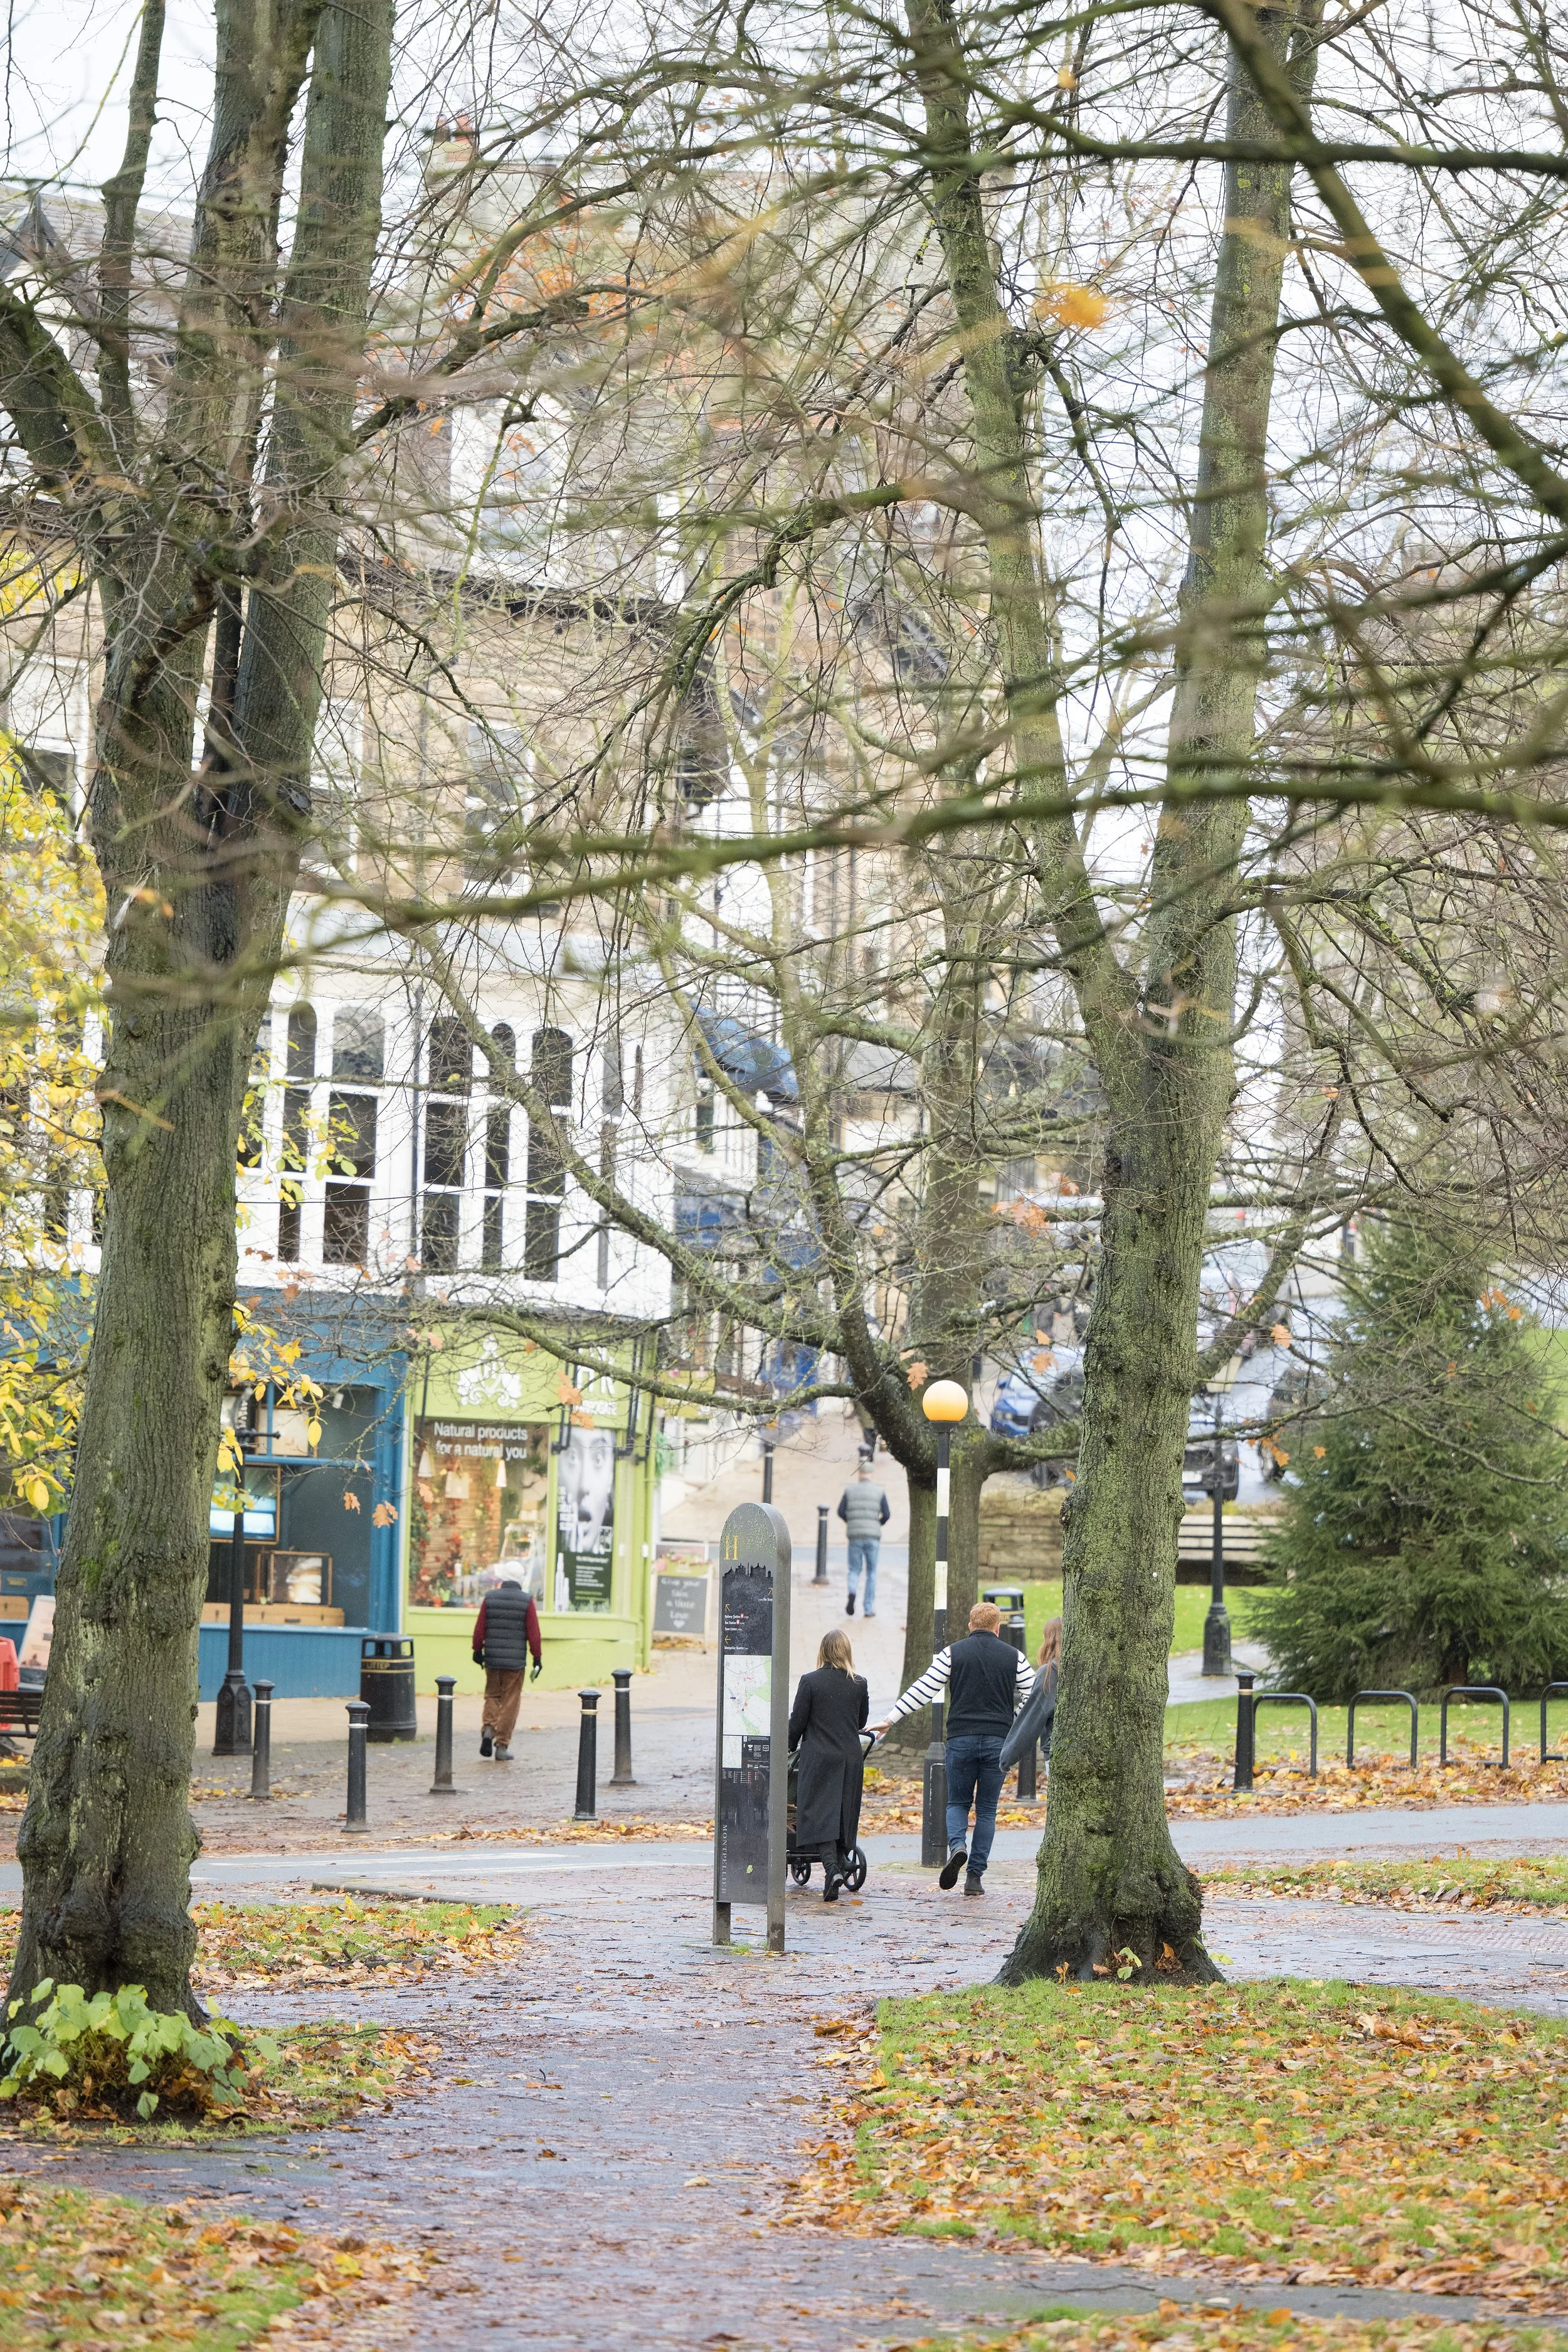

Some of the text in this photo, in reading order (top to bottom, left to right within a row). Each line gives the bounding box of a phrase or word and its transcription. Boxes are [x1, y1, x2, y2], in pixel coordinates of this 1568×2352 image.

[434, 1421, 528, 1441] Natural products
[436, 1439, 527, 1461] for a natural you
[661, 1577, 681, 1586] Give
